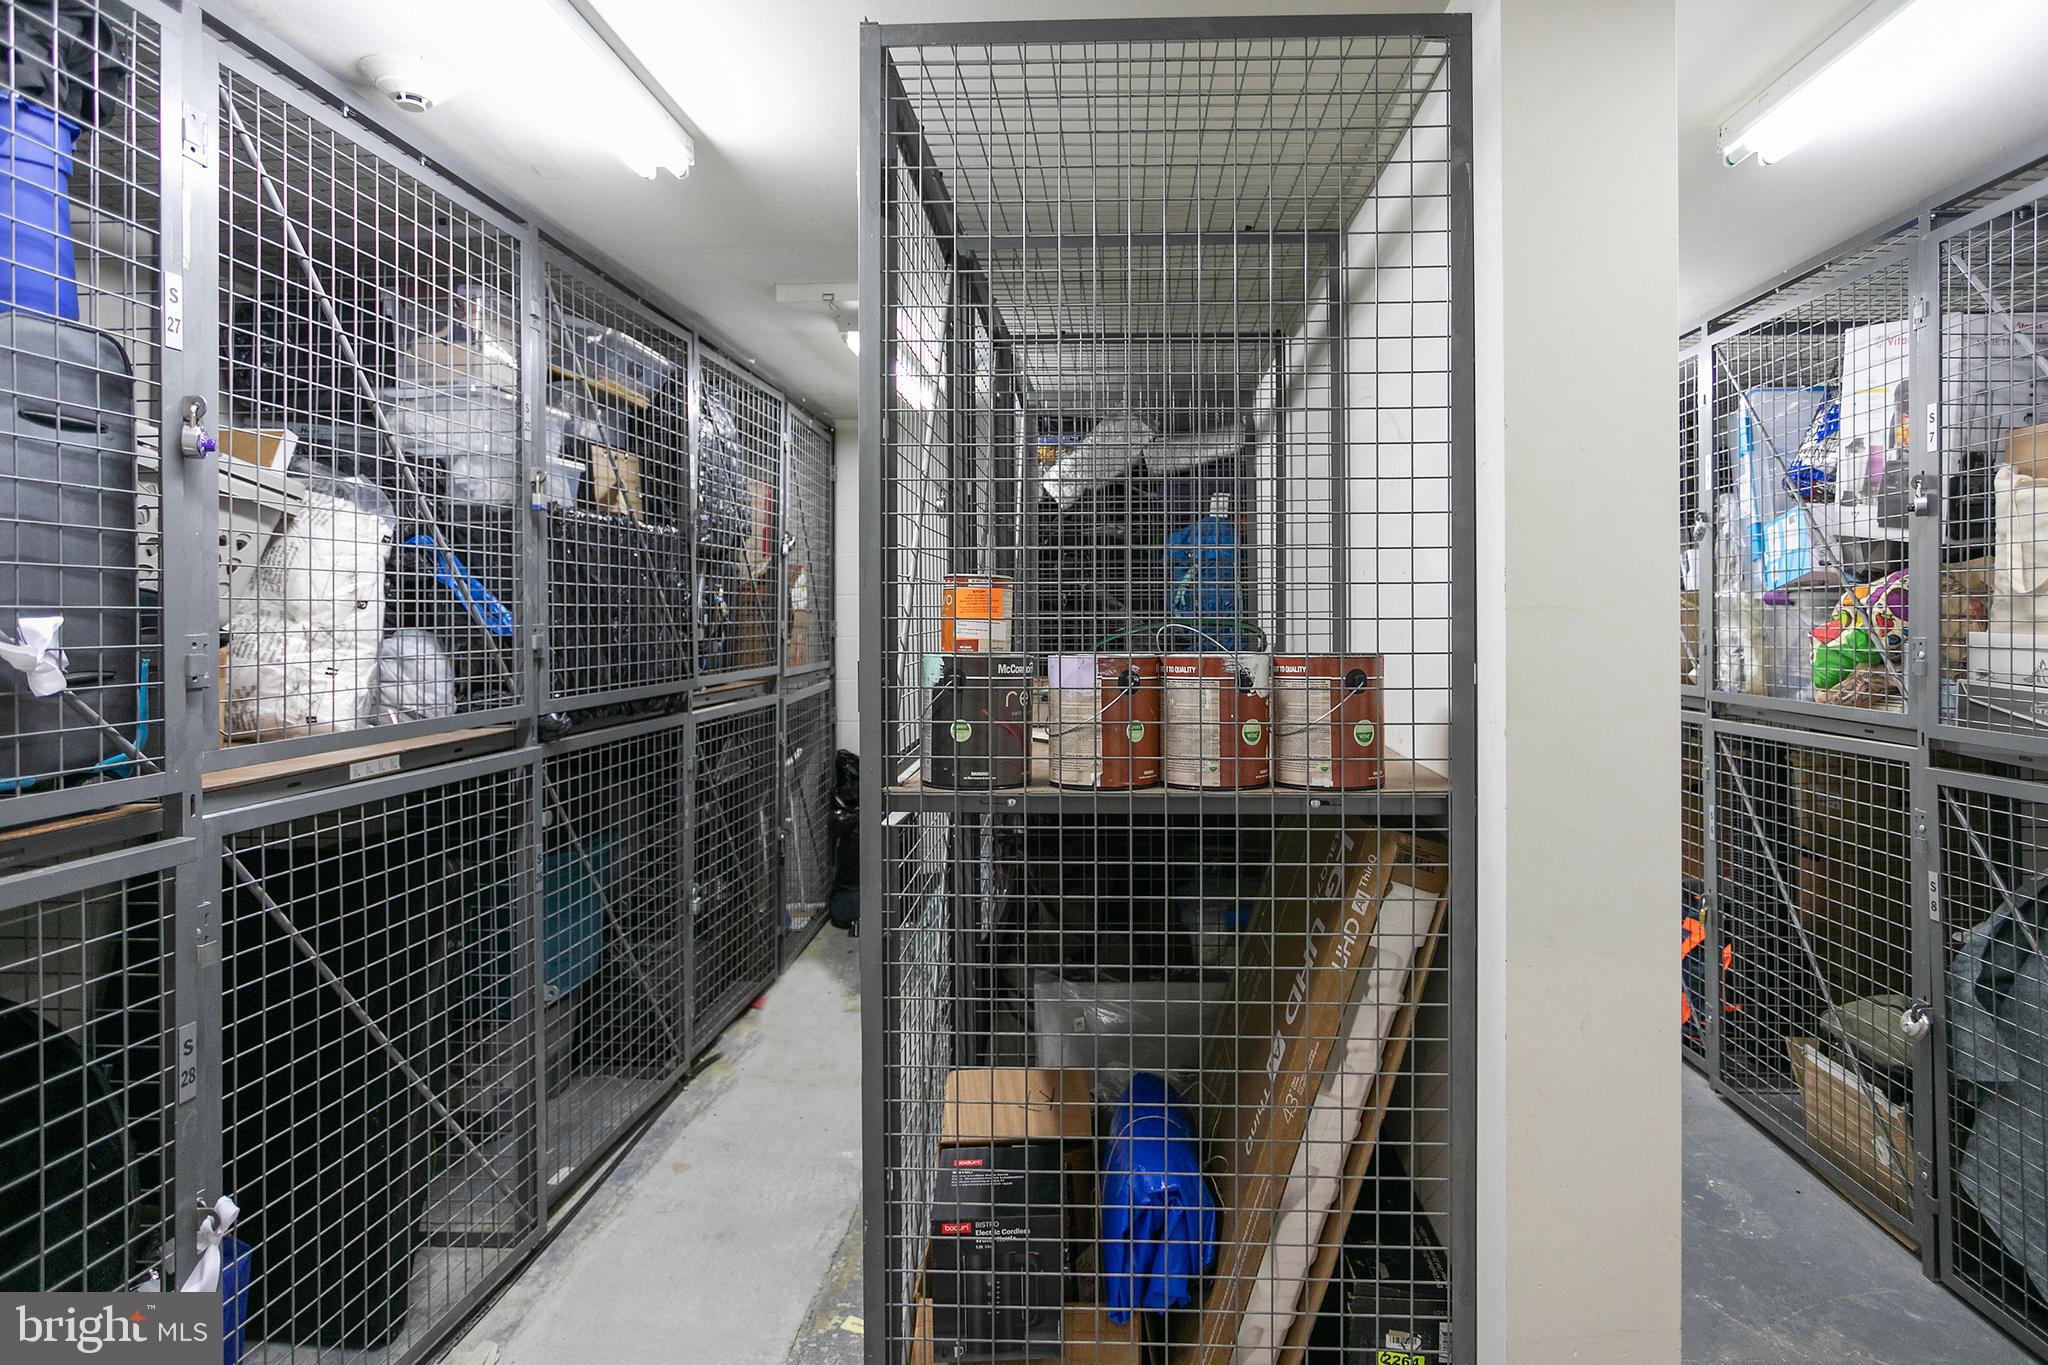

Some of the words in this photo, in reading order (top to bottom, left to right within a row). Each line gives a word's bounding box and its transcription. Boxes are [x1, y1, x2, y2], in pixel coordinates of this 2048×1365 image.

[169, 287, 179, 304] S
[167, 316, 181, 334] 27
[525, 403, 530, 413] S
[1929, 412, 1935, 424] S
[1929, 431, 1935, 443] 7
[1930, 881, 1937, 892] S
[1931, 900, 1937, 911] 8
[1331, 917, 1360, 972] UHD
[183, 1038, 194, 1056] S
[181, 1066, 196, 1088] 28
[975, 1228, 1001, 1236] Electic
